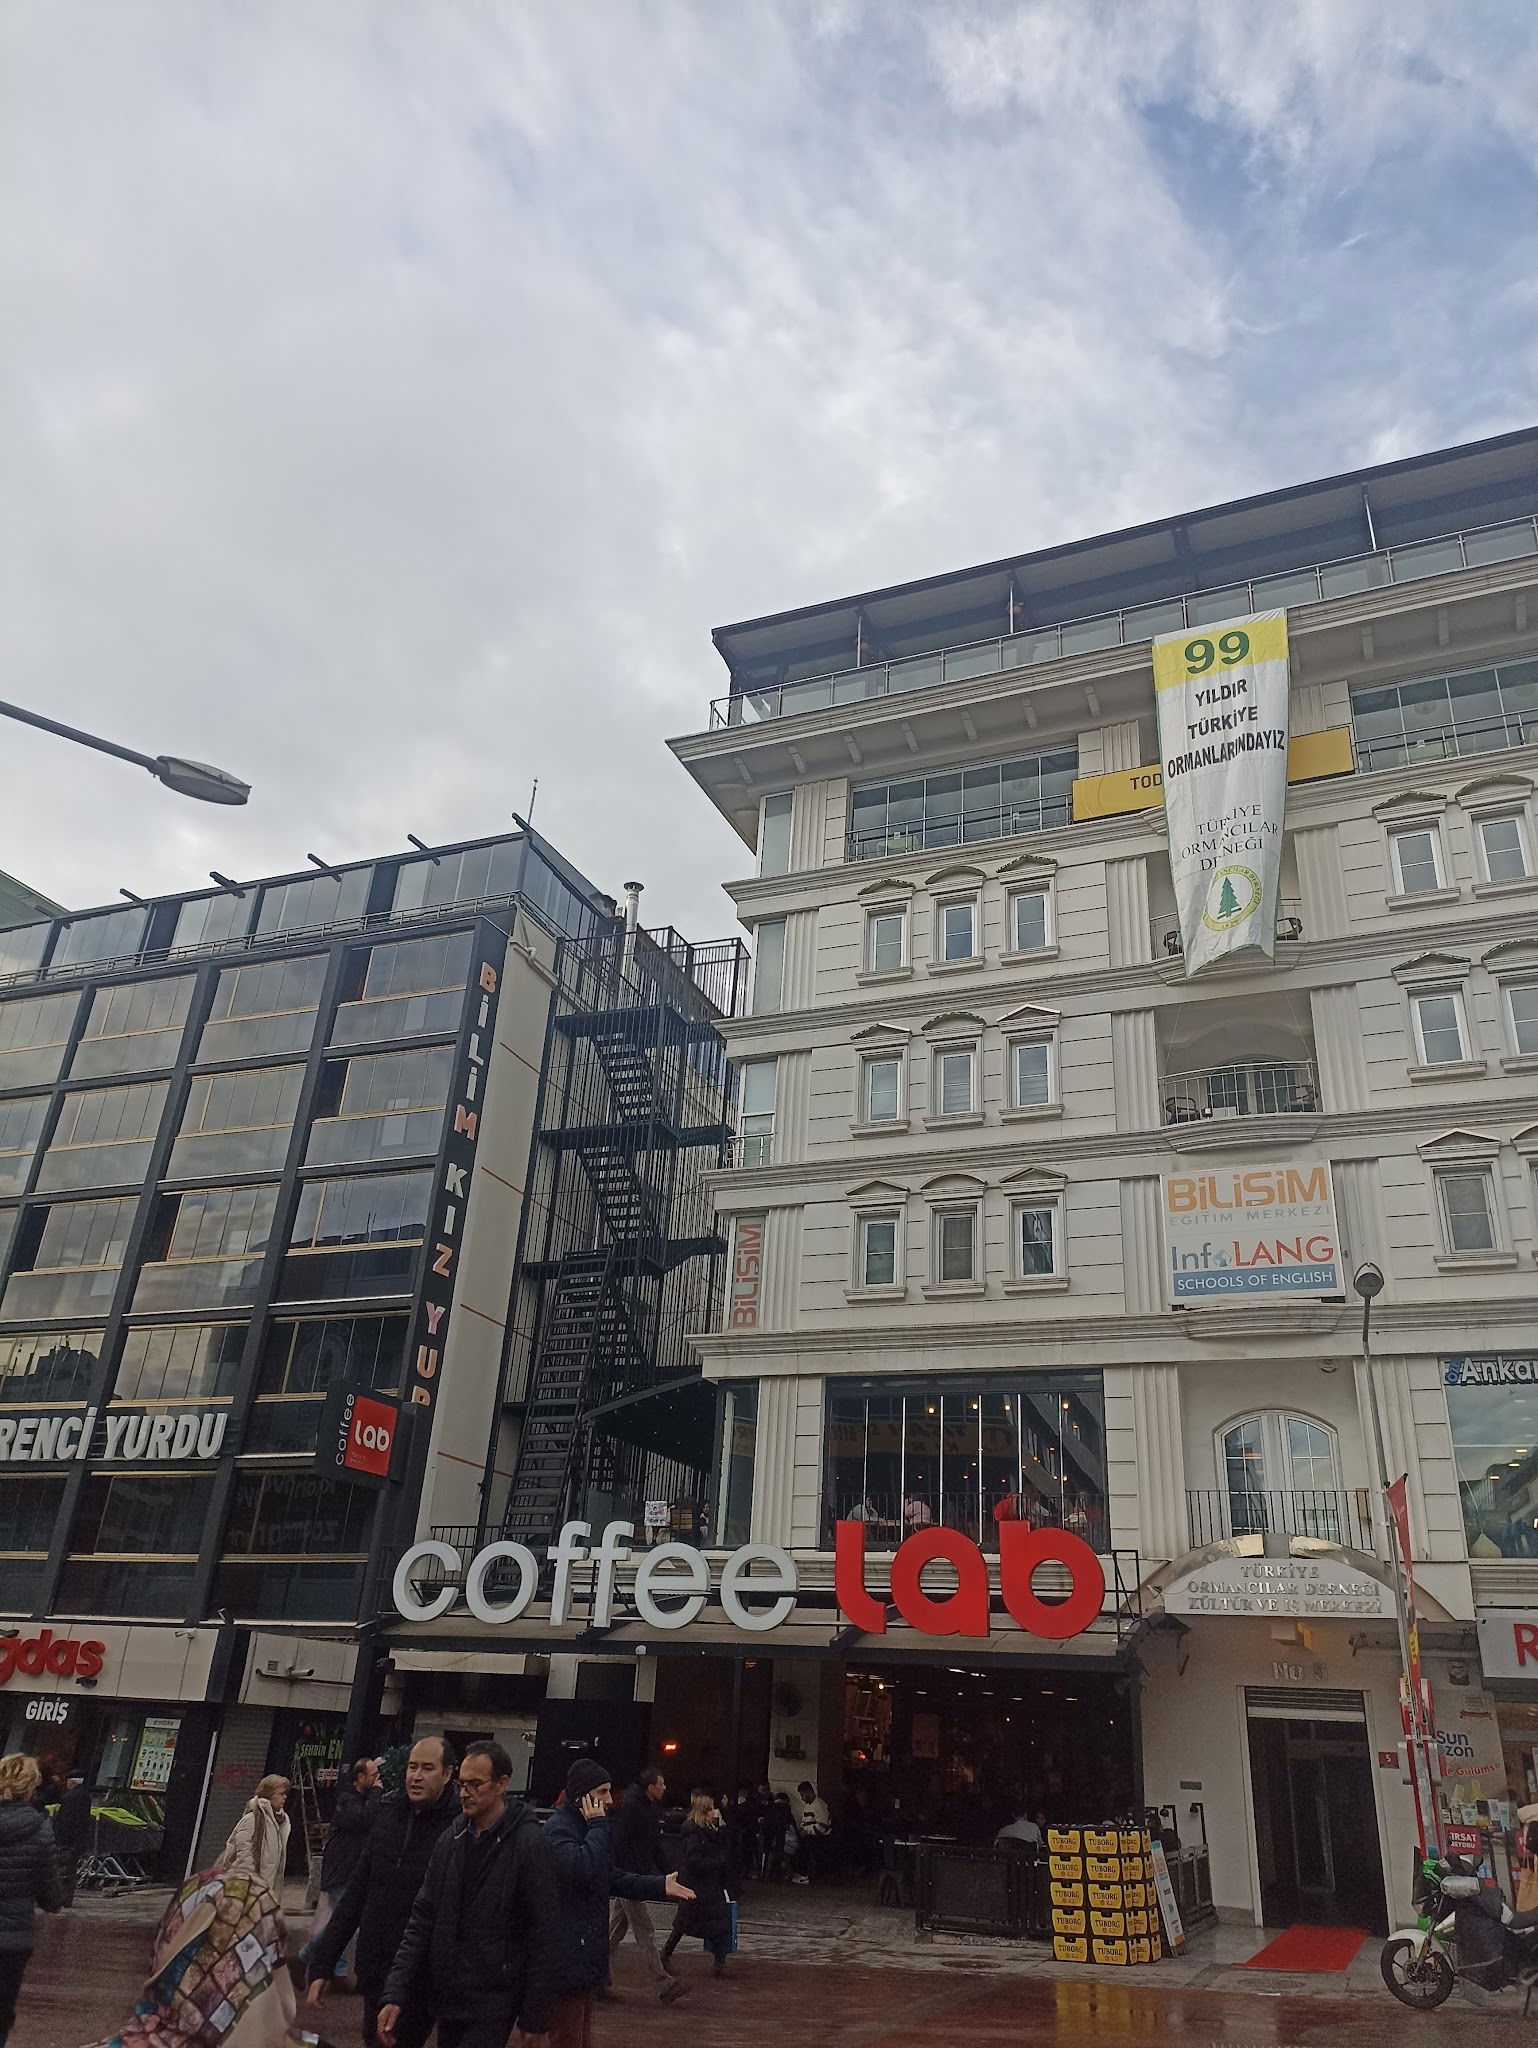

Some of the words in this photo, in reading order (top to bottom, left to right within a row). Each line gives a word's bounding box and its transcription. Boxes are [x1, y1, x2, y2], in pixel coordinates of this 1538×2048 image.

[1184, 630, 1250, 675] 99
[1194, 678, 1248, 707] YILDIR
[1187, 705, 1258, 740] TÜRKİYE
[1167, 729, 1285, 779] ORMANLARINDAYIZ
[453, 961, 498, 1141] BİLİM
[432, 1162, 468, 1278] KIZ
[1177, 1275, 1244, 1291] SCHOOLS
[1248, 1274, 1268, 1287] OF
[1271, 1271, 1333, 1285] ENGLISH
[103, 1412, 229, 1460] YURDU
[335, 1393, 355, 1466] coffee
[354, 1420, 390, 1452] lab
[393, 1520, 800, 1632] coffee
[834, 1519, 1106, 1640] lab
[1240, 1563, 1321, 1579] TÜRKİYE
[1187, 1581, 1299, 1596] ORMANCILAR
[1305, 1580, 1382, 1597] DERNEĞİ
[1187, 1595, 1254, 1612] KÜLTÜR
[1256, 1598, 1279, 1612] VE
[1304, 1598, 1383, 1615] MERKEZİ
[1272, 1662, 1304, 1681] No
[25, 1696, 70, 1725] GİRİŞ
[1436, 1729, 1469, 1746] Sun
[1445, 1745, 1474, 1758] zon
[1052, 1837, 1077, 1845] TUBORG
[1089, 1838, 1114, 1846] TUBORG
[1053, 1863, 1078, 1871] TUBORG
[1091, 1865, 1116, 1873] TUBORG
[1055, 1890, 1080, 1898] TUBORG
[1092, 1892, 1118, 1900] TUBORG
[1056, 1917, 1082, 1925] TUBORG
[1095, 1919, 1120, 1928] TUBORG
[1058, 1945, 1083, 1953] TUBORG
[1097, 1947, 1123, 1955] TUBORG
